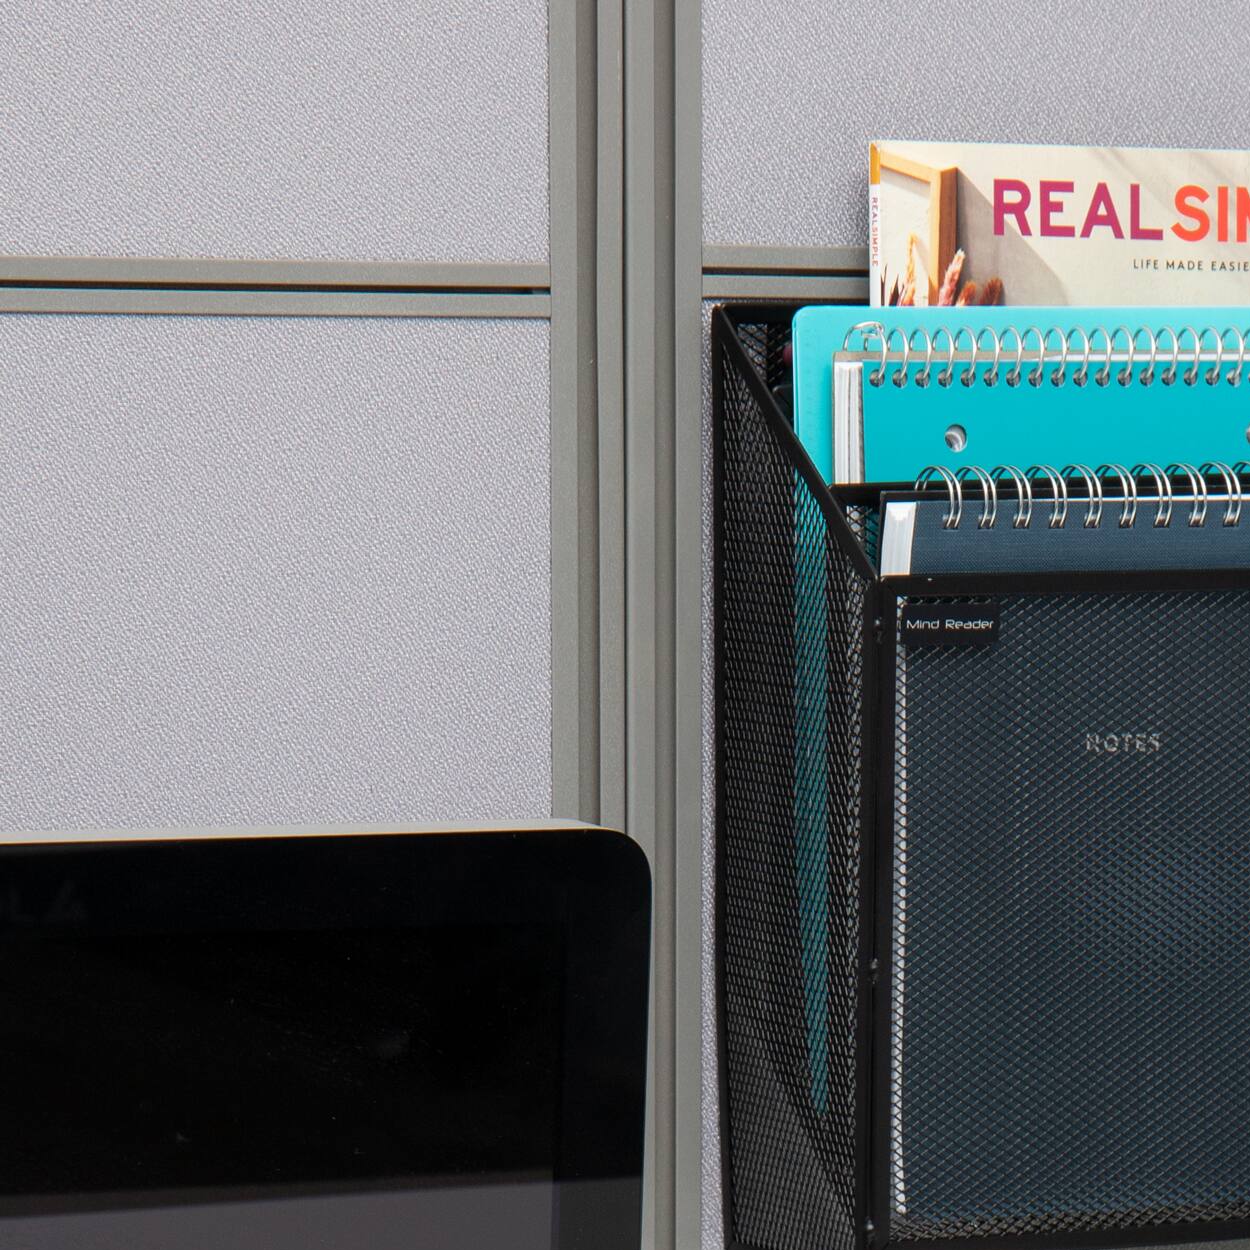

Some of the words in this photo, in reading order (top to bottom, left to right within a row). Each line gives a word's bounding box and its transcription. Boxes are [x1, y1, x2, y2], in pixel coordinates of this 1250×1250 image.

[993, 178, 1163, 241] REAL
[1133, 259, 1159, 270] LIFE
[1166, 260, 1204, 271] MADE
[906, 619, 940, 630] Mind
[945, 619, 994, 630] Reader
[1086, 732, 1160, 753] NOTES
